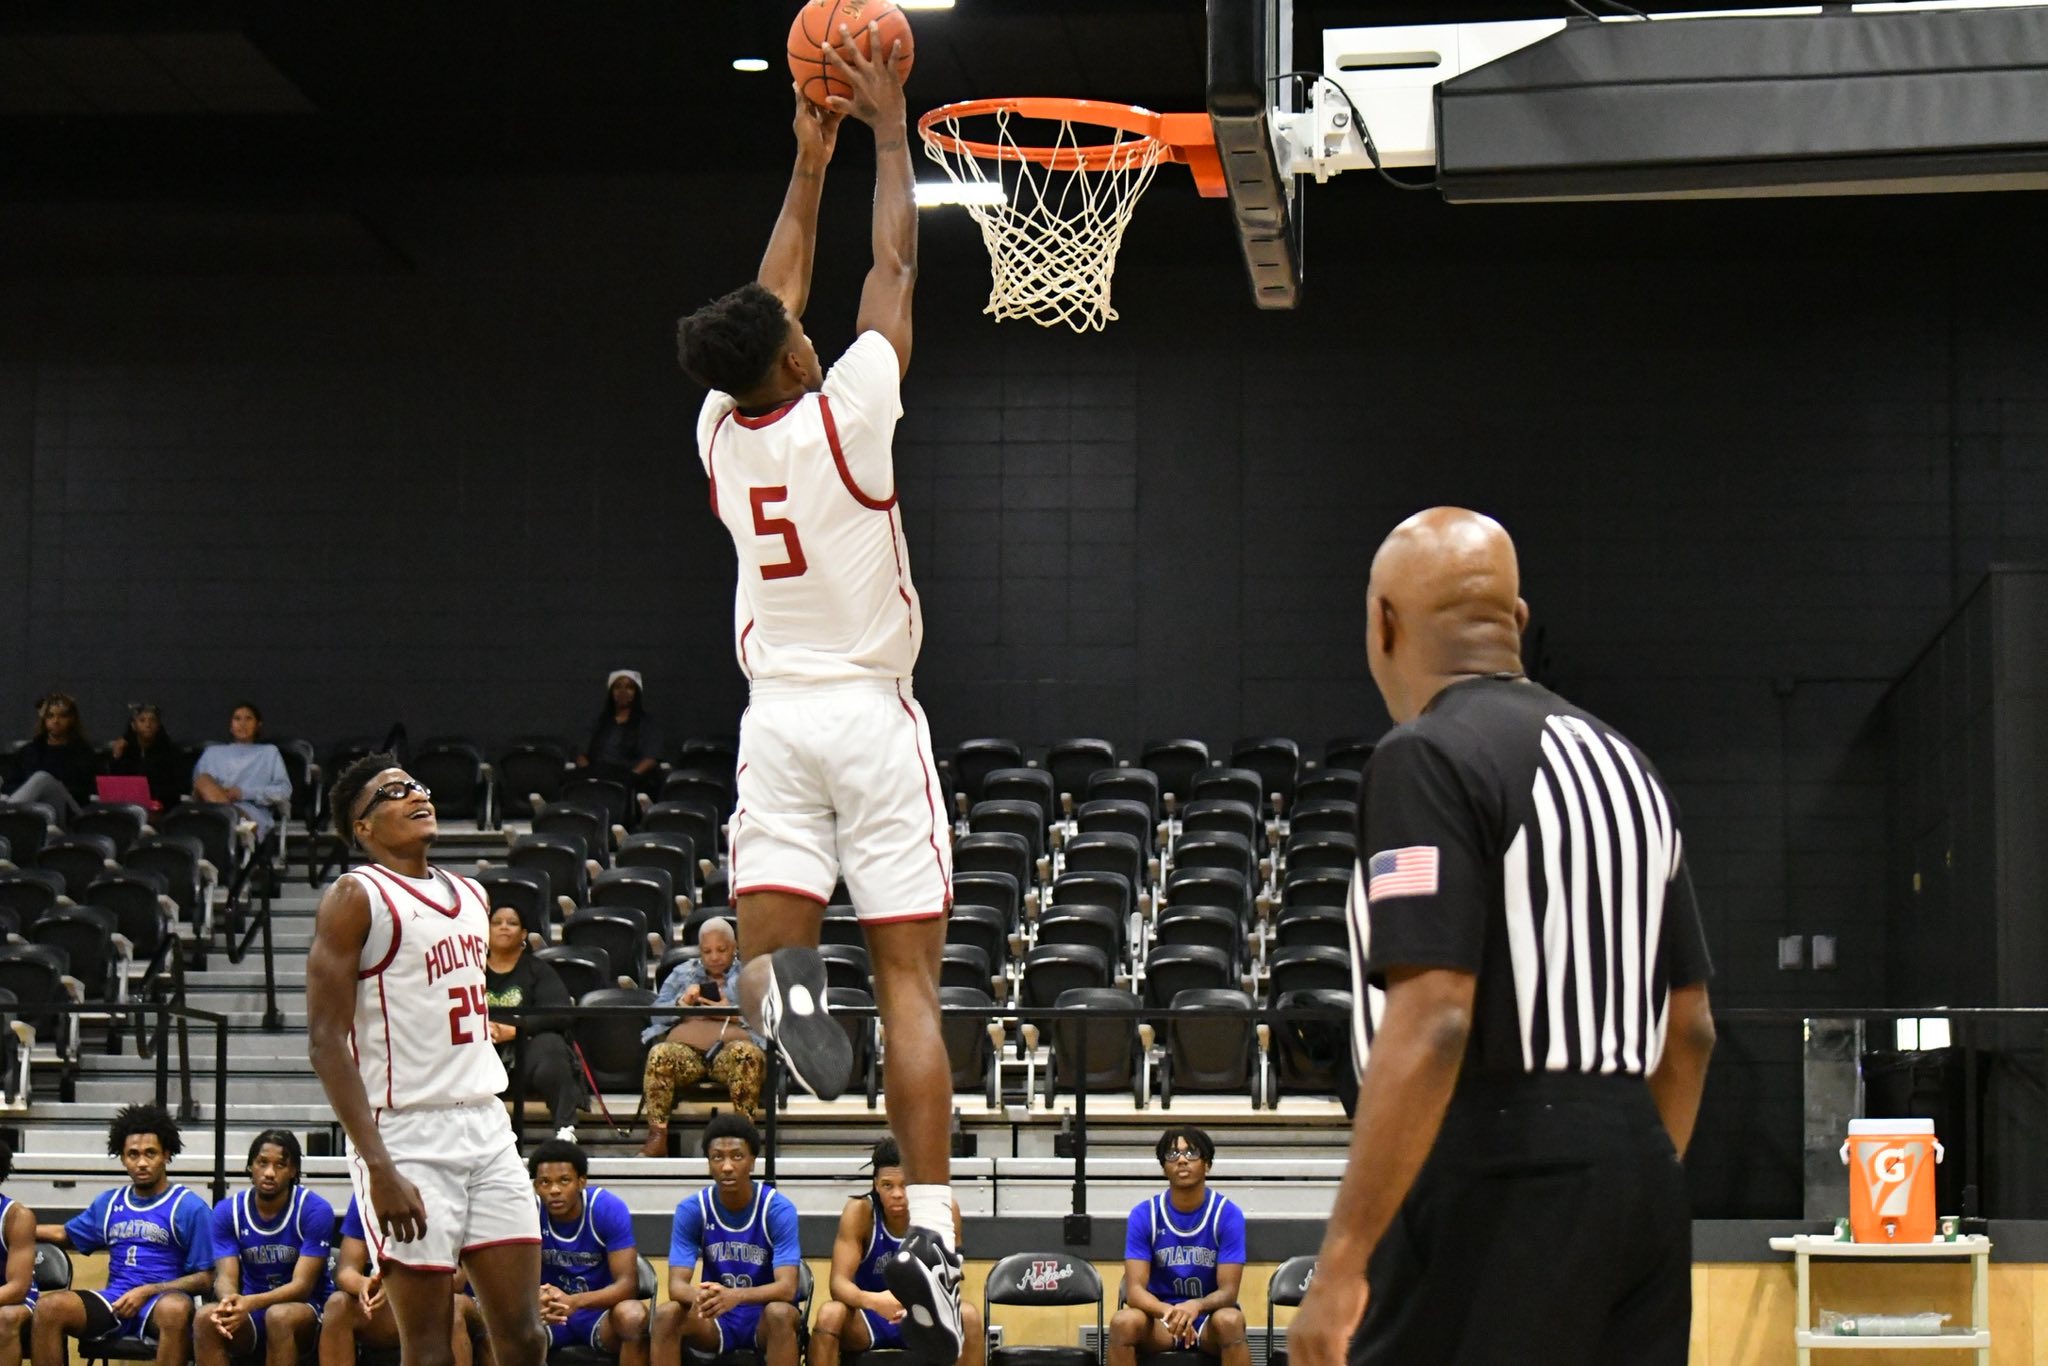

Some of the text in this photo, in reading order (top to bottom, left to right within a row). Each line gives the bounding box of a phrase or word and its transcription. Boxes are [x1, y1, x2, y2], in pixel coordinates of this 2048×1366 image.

[749, 485, 808, 580] 5
[425, 934, 488, 986] HOLME
[448, 984, 488, 1045] 24
[1875, 1148, 1905, 1182] G
[124, 1245, 138, 1267] 1
[243, 1244, 297, 1265] VIATOR
[1172, 1276, 1204, 1298] 10
